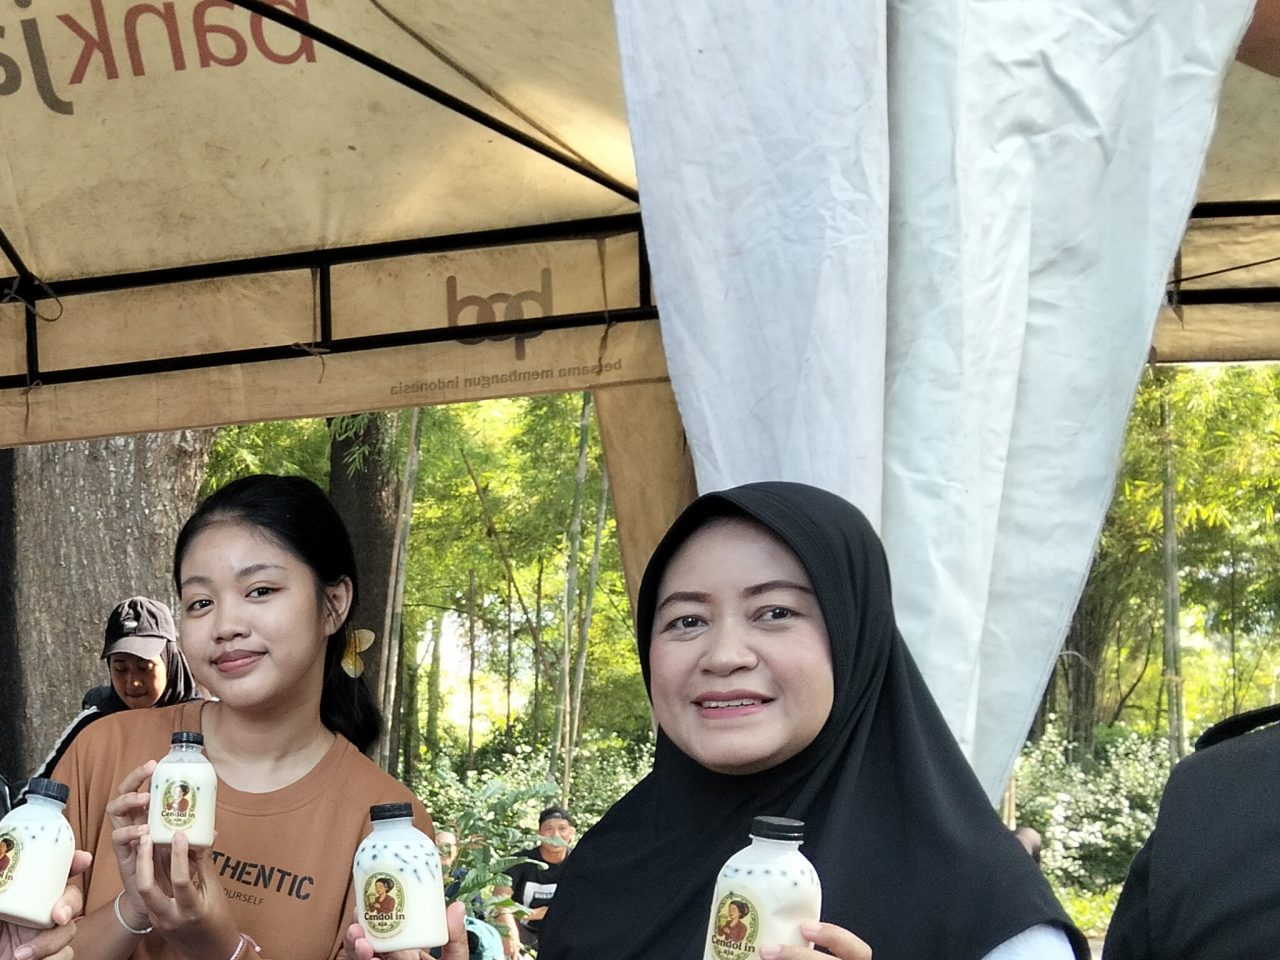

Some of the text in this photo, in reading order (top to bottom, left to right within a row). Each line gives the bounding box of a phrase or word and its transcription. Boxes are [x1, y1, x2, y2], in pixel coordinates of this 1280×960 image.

[210, 850, 314, 900] THENTIC
[364, 912, 405, 921] Cendol in
[711, 934, 756, 953] Cendol in
